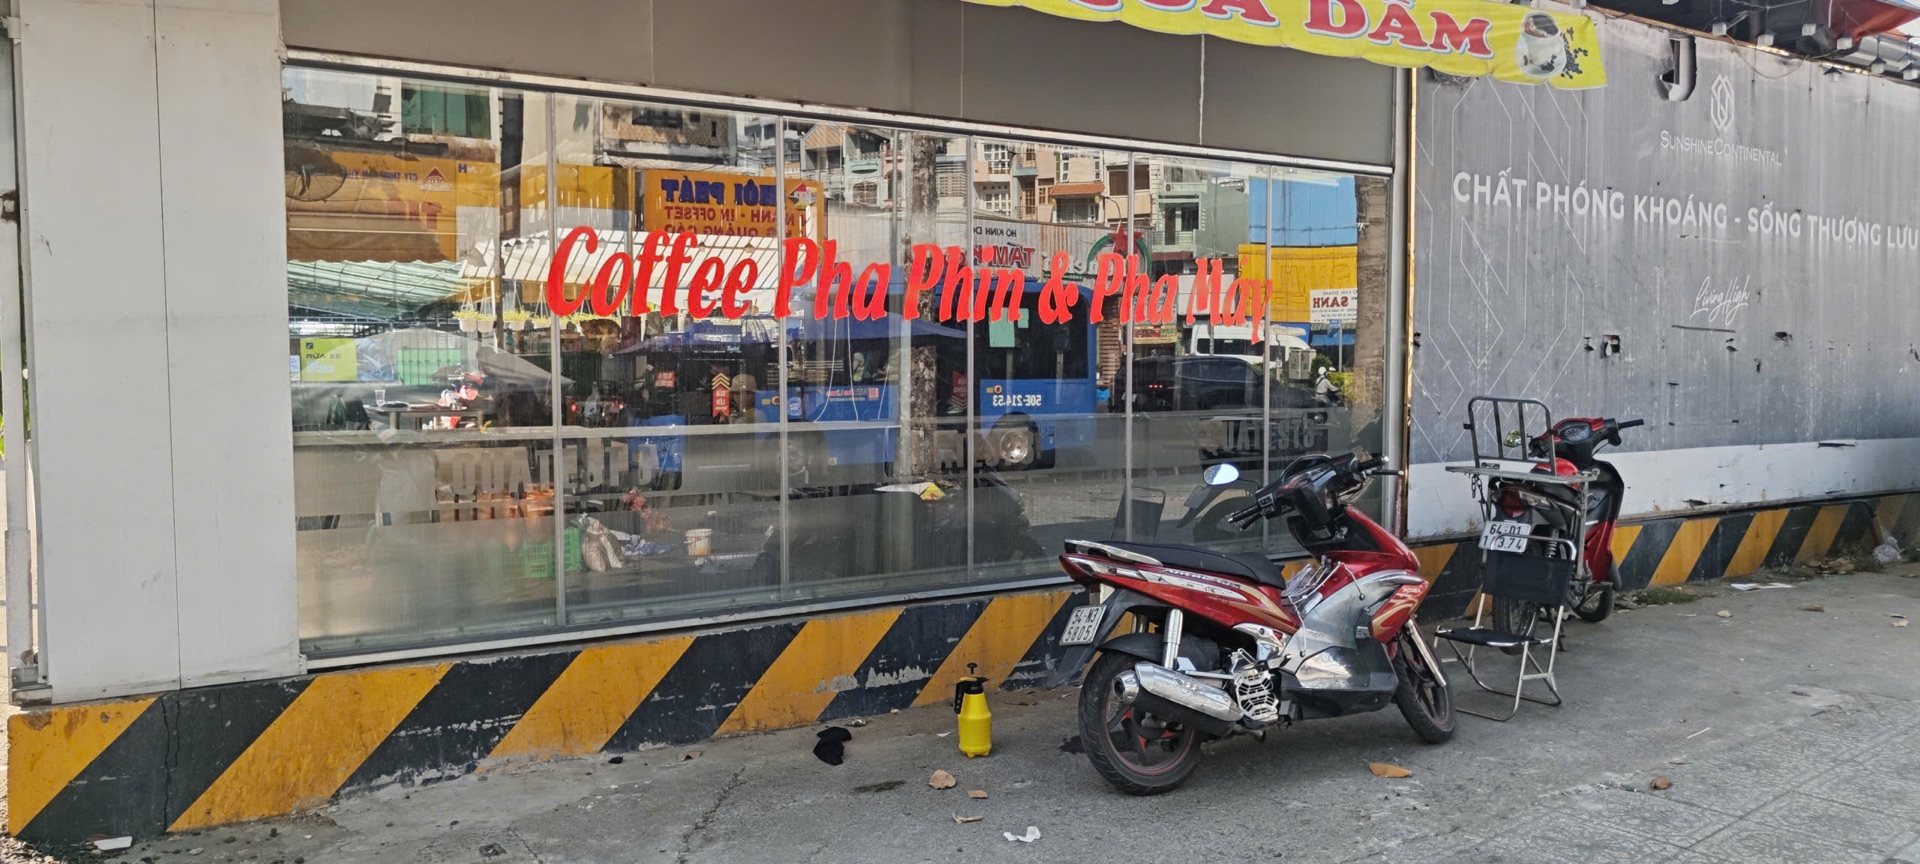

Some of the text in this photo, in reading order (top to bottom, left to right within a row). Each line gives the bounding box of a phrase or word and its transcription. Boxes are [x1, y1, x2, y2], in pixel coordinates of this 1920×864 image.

[1453, 167, 1527, 207] CHẤT
[1536, 180, 1625, 219] PHÓNG
[1633, 194, 1727, 229] KHOÁNG
[1747, 202, 1801, 238] SỐNG
[1807, 215, 1881, 249] THƯỢNG
[1887, 224, 1919, 250] LƯU
[546, 226, 1274, 345] Coffee Pha Phin & Pha Máy
[1489, 524, 1521, 535] 64-D1
[1072, 608, 1099, 624] 54-N3
[1065, 625, 1093, 641] 5805
